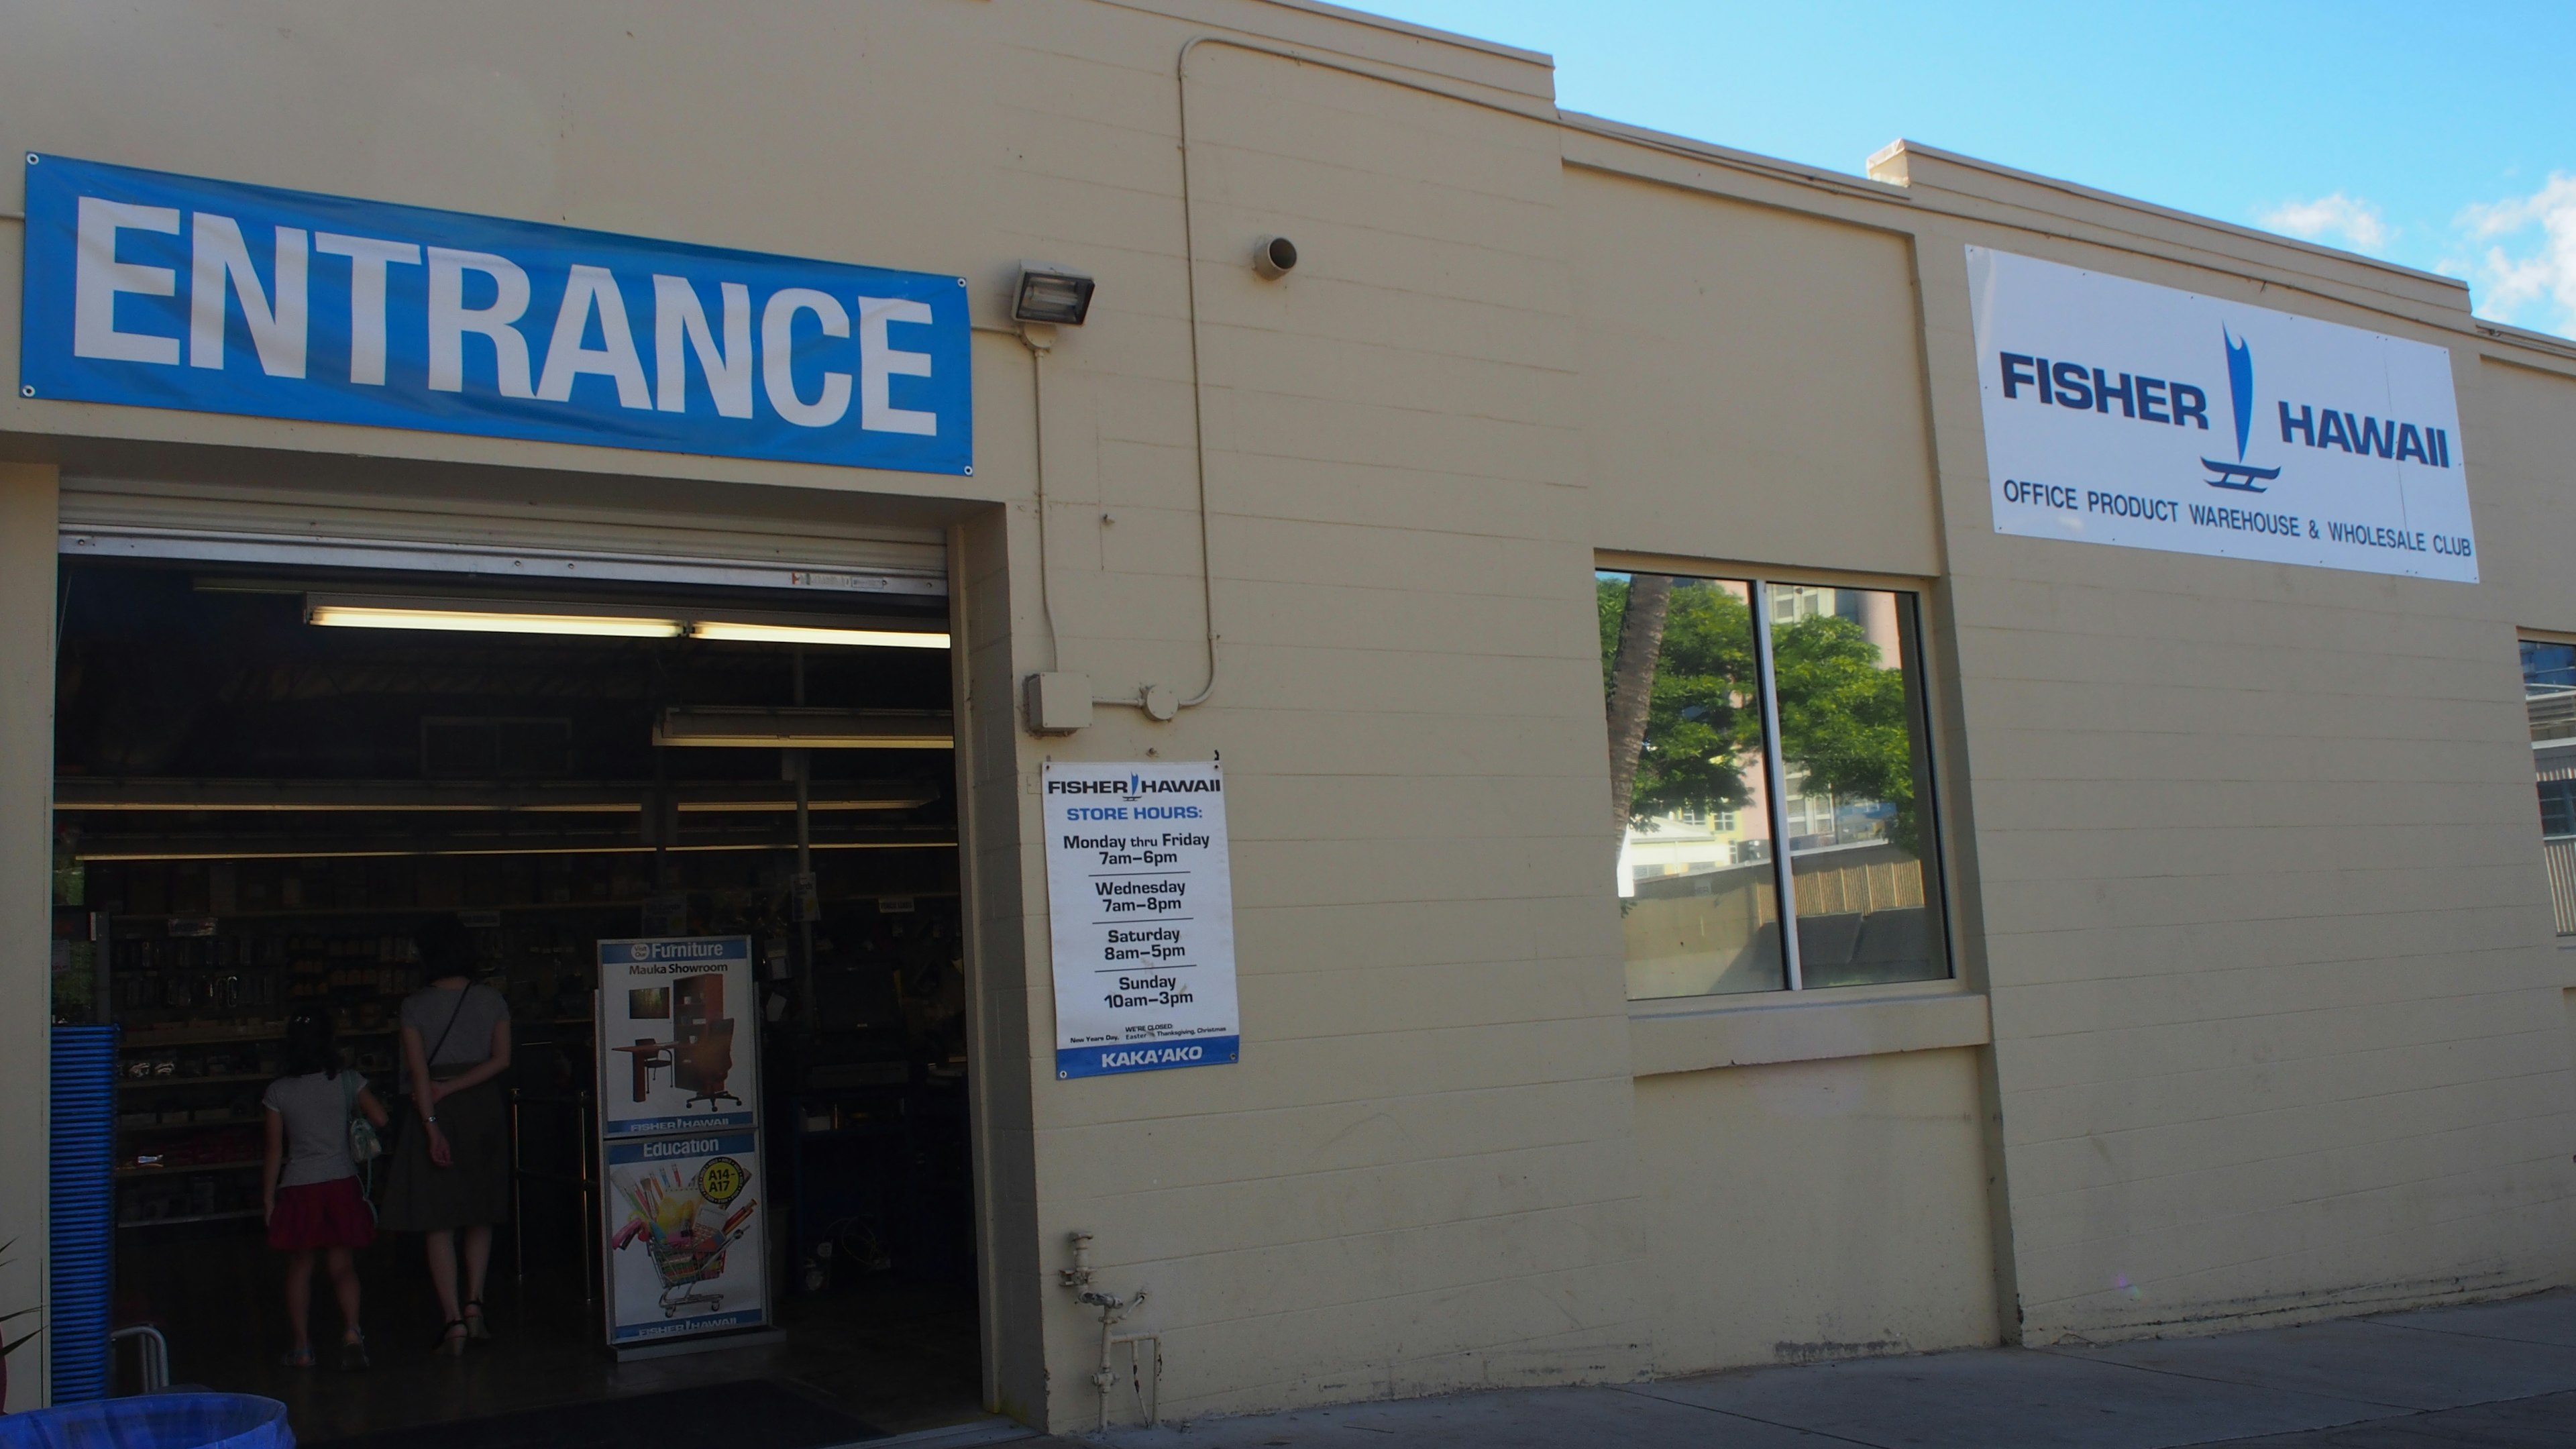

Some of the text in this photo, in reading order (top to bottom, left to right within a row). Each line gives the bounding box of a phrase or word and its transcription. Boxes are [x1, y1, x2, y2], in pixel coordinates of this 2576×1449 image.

[73, 196, 938, 437] ENTRANCE
[2000, 351, 2451, 470] FISHER HAWAII
[2003, 479, 2473, 558] OFFICE PRODUCT WAREHOUSE & WHOLESALE CLUB
[1048, 779, 1221, 794] FISHER HAWAII
[1067, 806, 1203, 821] STORE HOURS:
[1063, 833, 1210, 851] Monday thru Friday
[1095, 880, 1185, 896] Wednesday
[1108, 927, 1180, 943] Saturday
[651, 943, 723, 958] Furniture
[629, 963, 728, 975] Mauka Showroom
[1119, 975, 1176, 991] Sunday
[631, 1118, 729, 1132] FISHER HAWAII
[643, 1139, 719, 1158] Education
[708, 1169, 736, 1181] A14-
[709, 1181, 731, 1193] A17
[639, 1317, 737, 1336] FISHER HAWAII
